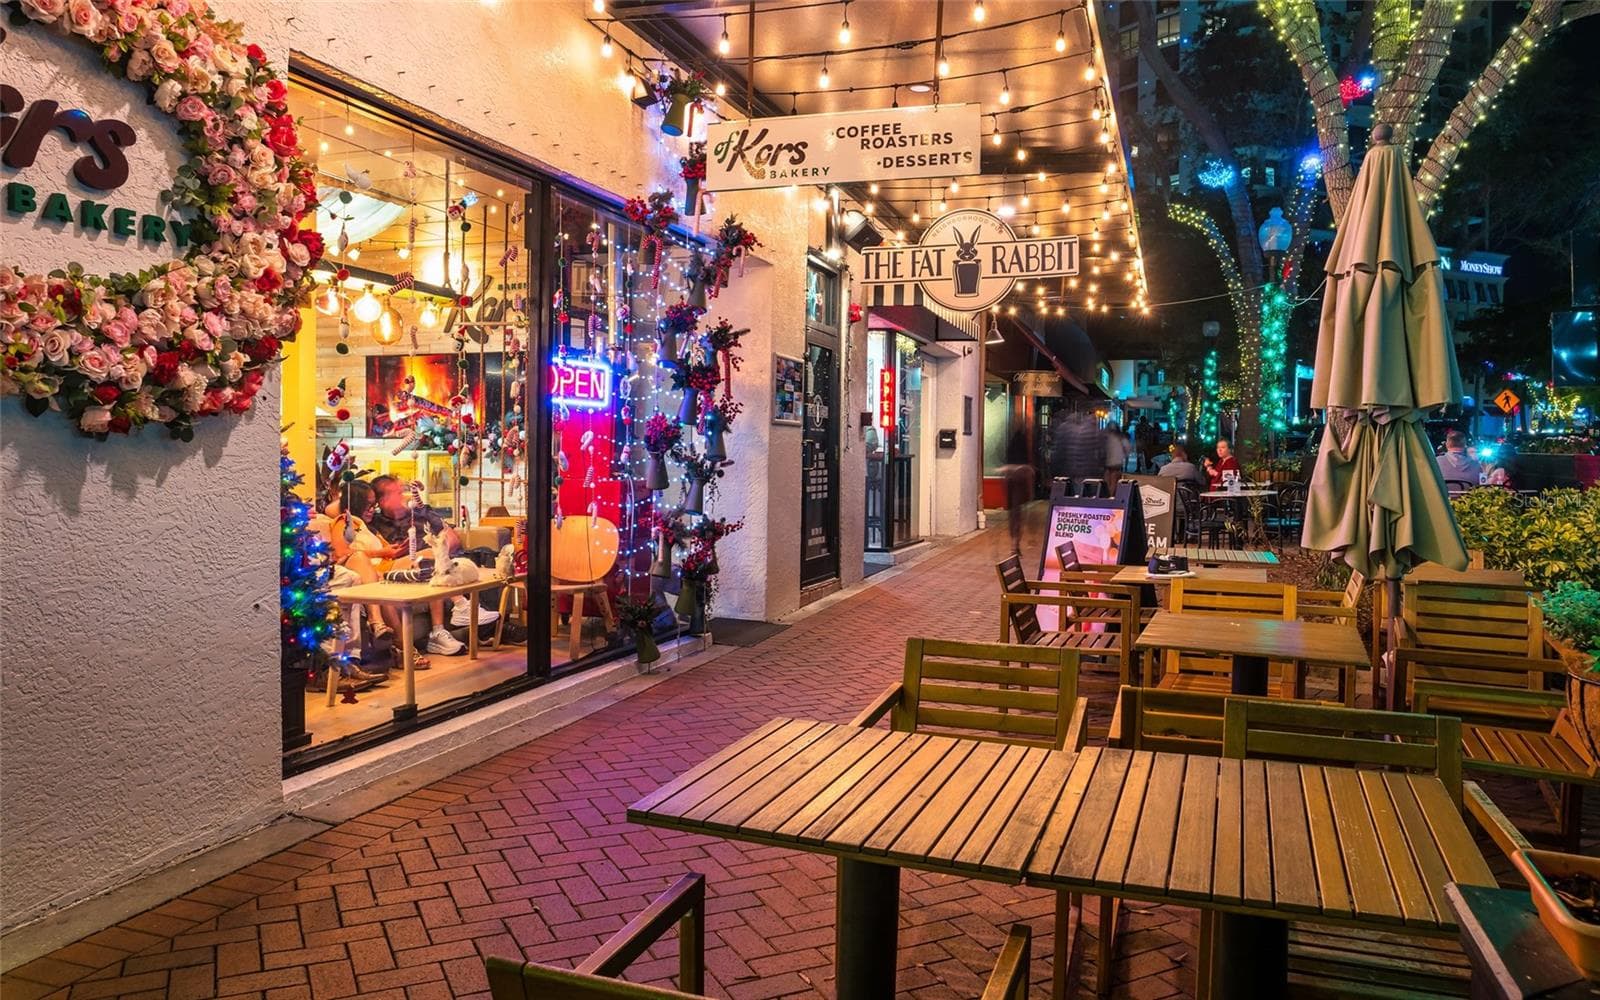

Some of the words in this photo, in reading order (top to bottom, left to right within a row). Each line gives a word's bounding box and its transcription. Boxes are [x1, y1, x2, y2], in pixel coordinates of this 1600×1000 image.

[836, 123, 902, 138] COFFEE
[860, 132, 953, 150] ROASTERS
[882, 151, 973, 168] DESSERTS
[770, 167, 830, 179] BAKERY
[7, 183, 192, 247] BAKERY
[862, 251, 904, 279] THE
[911, 249, 945, 278] FAT
[991, 240, 1077, 274] RABBIT
[882, 371, 890, 426] OPEN
[1056, 523, 1092, 534] OFKORS
[1057, 517, 1089, 525] SIGNATURE
